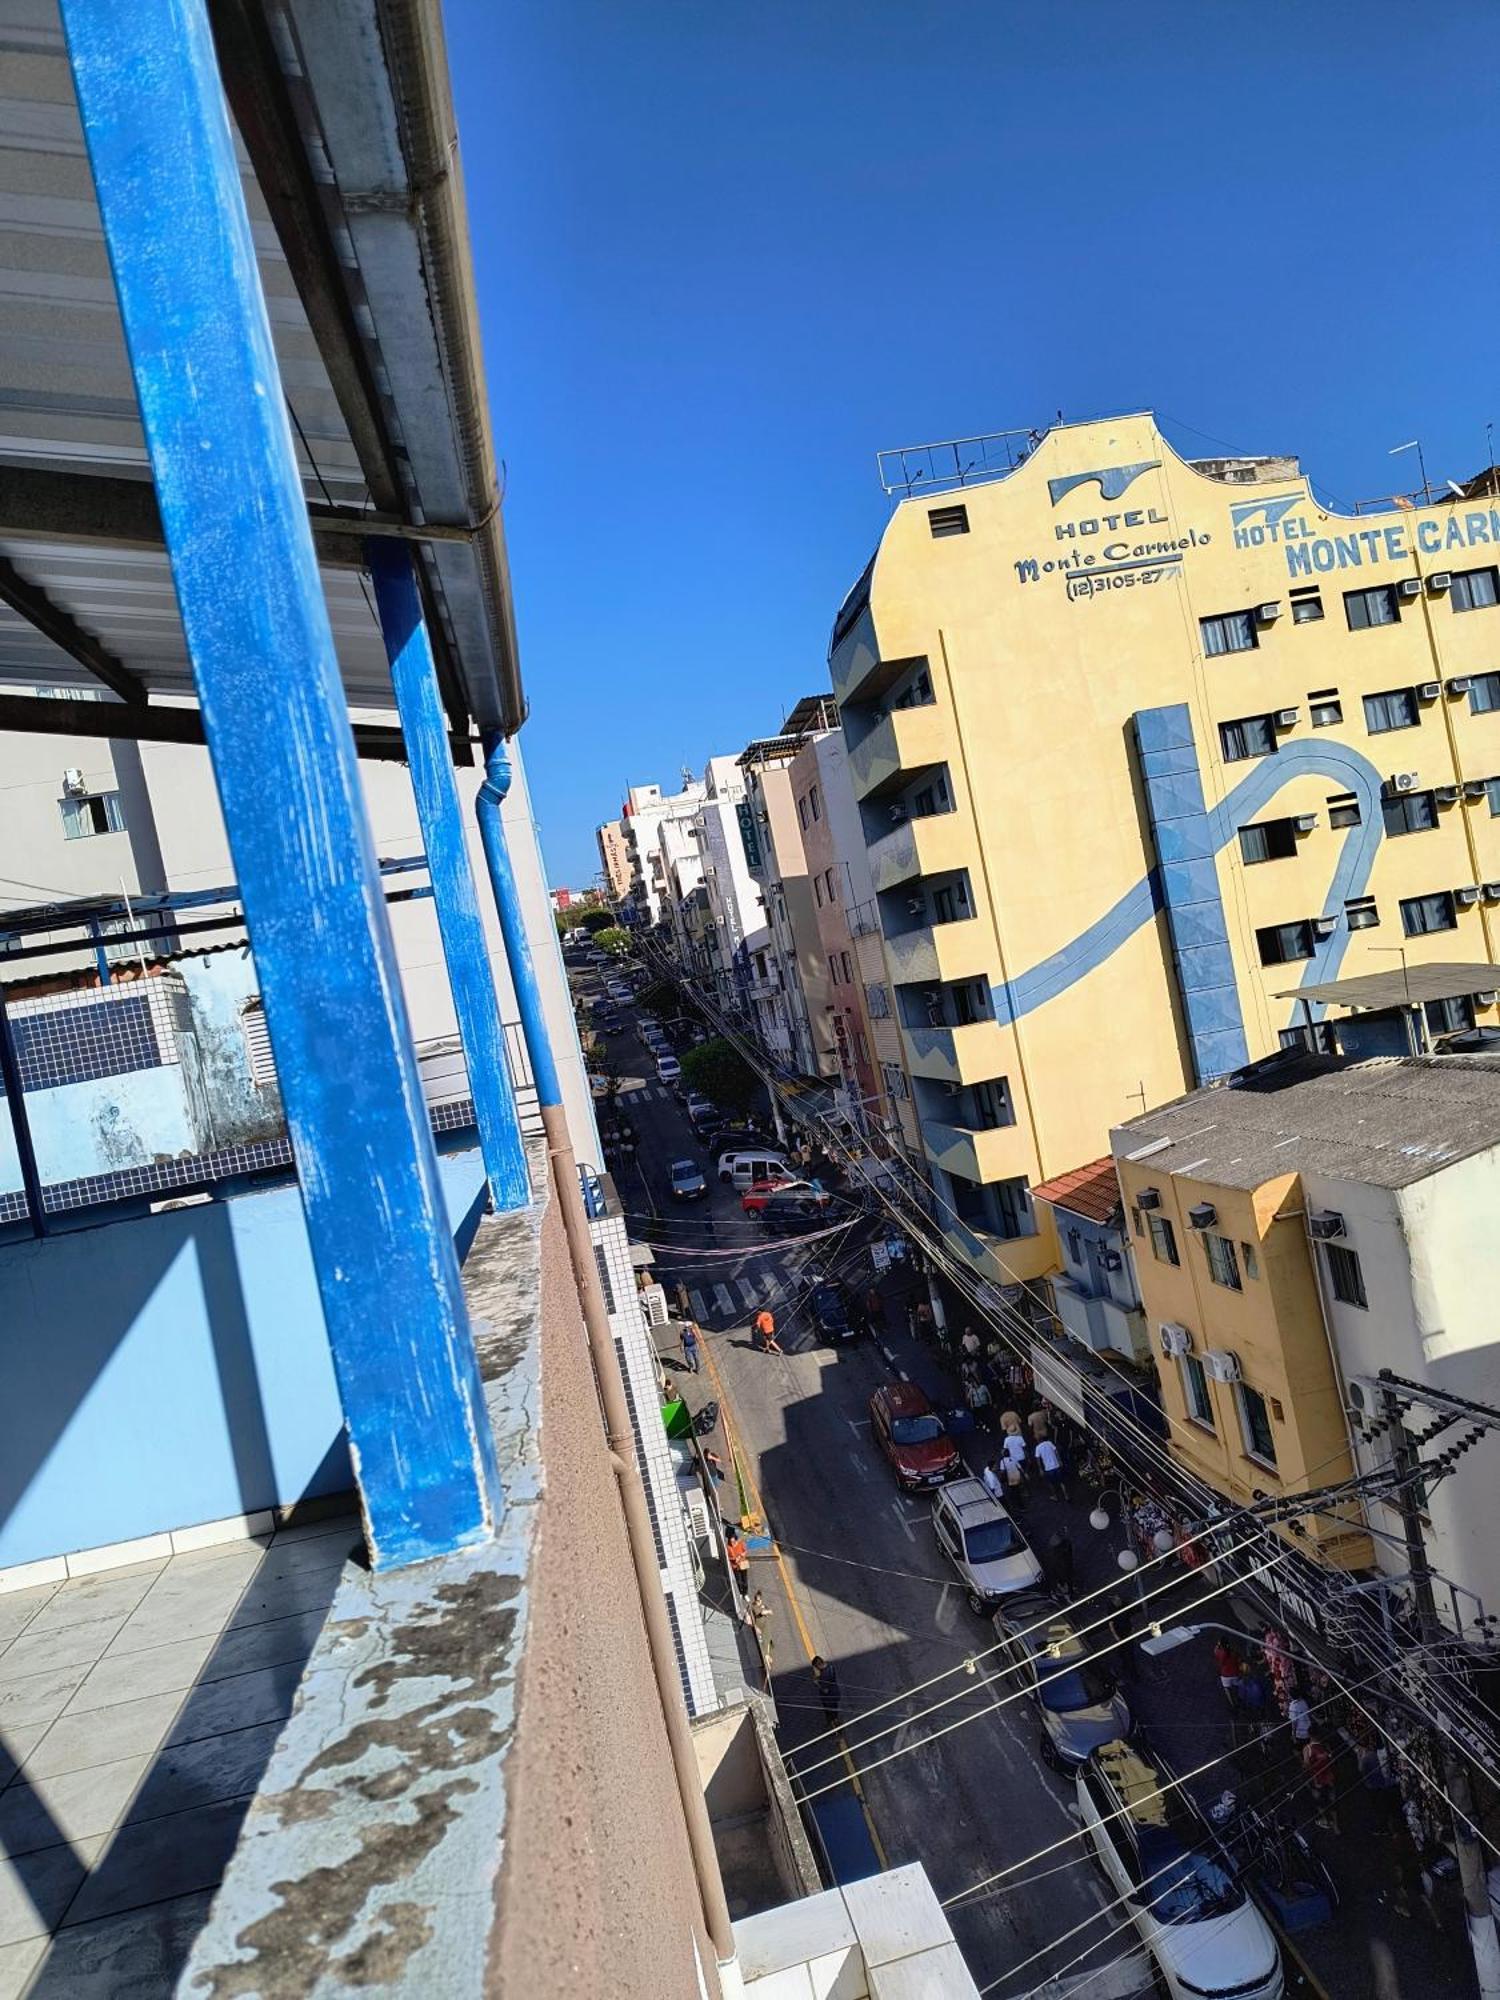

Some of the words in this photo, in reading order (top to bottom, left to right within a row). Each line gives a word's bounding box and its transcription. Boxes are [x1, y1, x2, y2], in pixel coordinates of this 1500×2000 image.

[1054, 508, 1169, 540] HOTEL
[1233, 516, 1316, 549] HOTEL
[1014, 549, 1096, 584] Monte
[1103, 528, 1212, 561] Carmelo
[1284, 525, 1408, 578] MONTE
[737, 805, 758, 865] HOTEL
